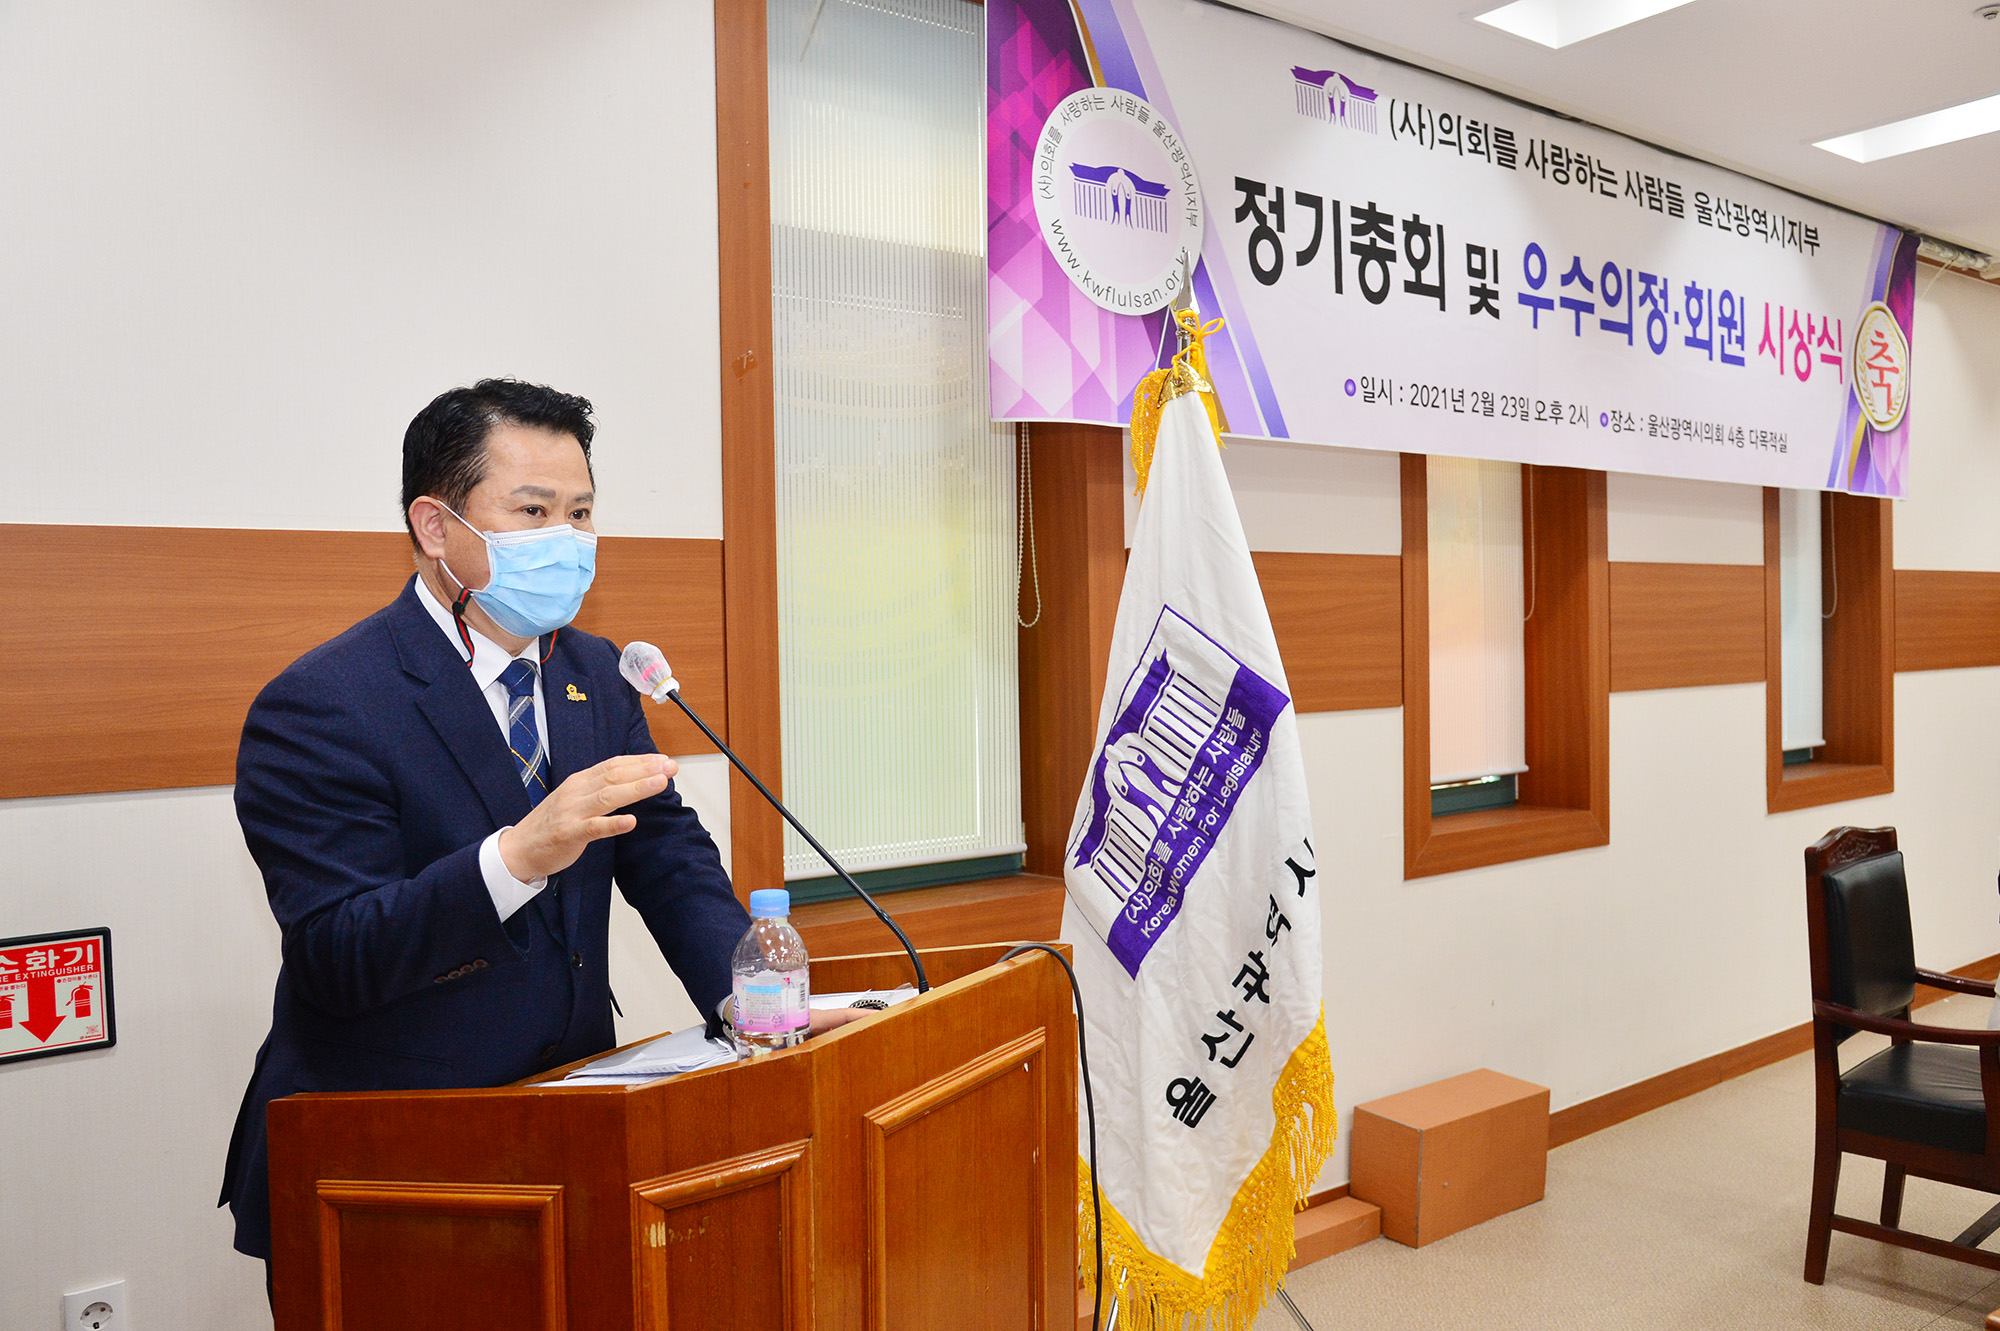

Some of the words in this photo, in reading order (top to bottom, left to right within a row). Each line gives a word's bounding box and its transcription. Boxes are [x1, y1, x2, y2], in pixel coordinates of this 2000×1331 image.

[1037, 125, 1064, 200] (사)의회를
[1060, 94, 1105, 126] 사랑하는
[1110, 95, 1151, 125] 사람들
[1153, 120, 1199, 227] 울산광역시지부
[1389, 98, 1518, 171] (사)의회를
[1525, 138, 1618, 199] 사랑하는
[1624, 169, 1685, 219] 사람들
[1693, 191, 1820, 256] 울산광역시지부
[1234, 176, 1446, 312] 정기총회
[1465, 242, 1500, 320] 및
[1758, 302, 1843, 384] 시상식
[1360, 376, 1393, 406] 일시
[1410, 383, 1465, 413] 2021년
[1471, 391, 1495, 417] 2월
[1500, 395, 1530, 422] 23일
[1534, 400, 1564, 425] 오후
[1568, 404, 1590, 428] 2시
[1610, 410, 1636, 433] 장소
[1648, 414, 1725, 446] 울산광역시의회
[1728, 426, 1745, 448] 4층
[1749, 429, 1789, 453] 다목적실
[1865, 330, 1900, 416] 축
[1125, 839, 1173, 924] (사)의회를
[1167, 766, 1214, 840] 사랑하는
[1206, 706, 1246, 764] 사람들
[1140, 895, 1177, 938] Korea
[1198, 807, 1221, 837] For
[15, 964, 94, 981] EXTINGUISHER
